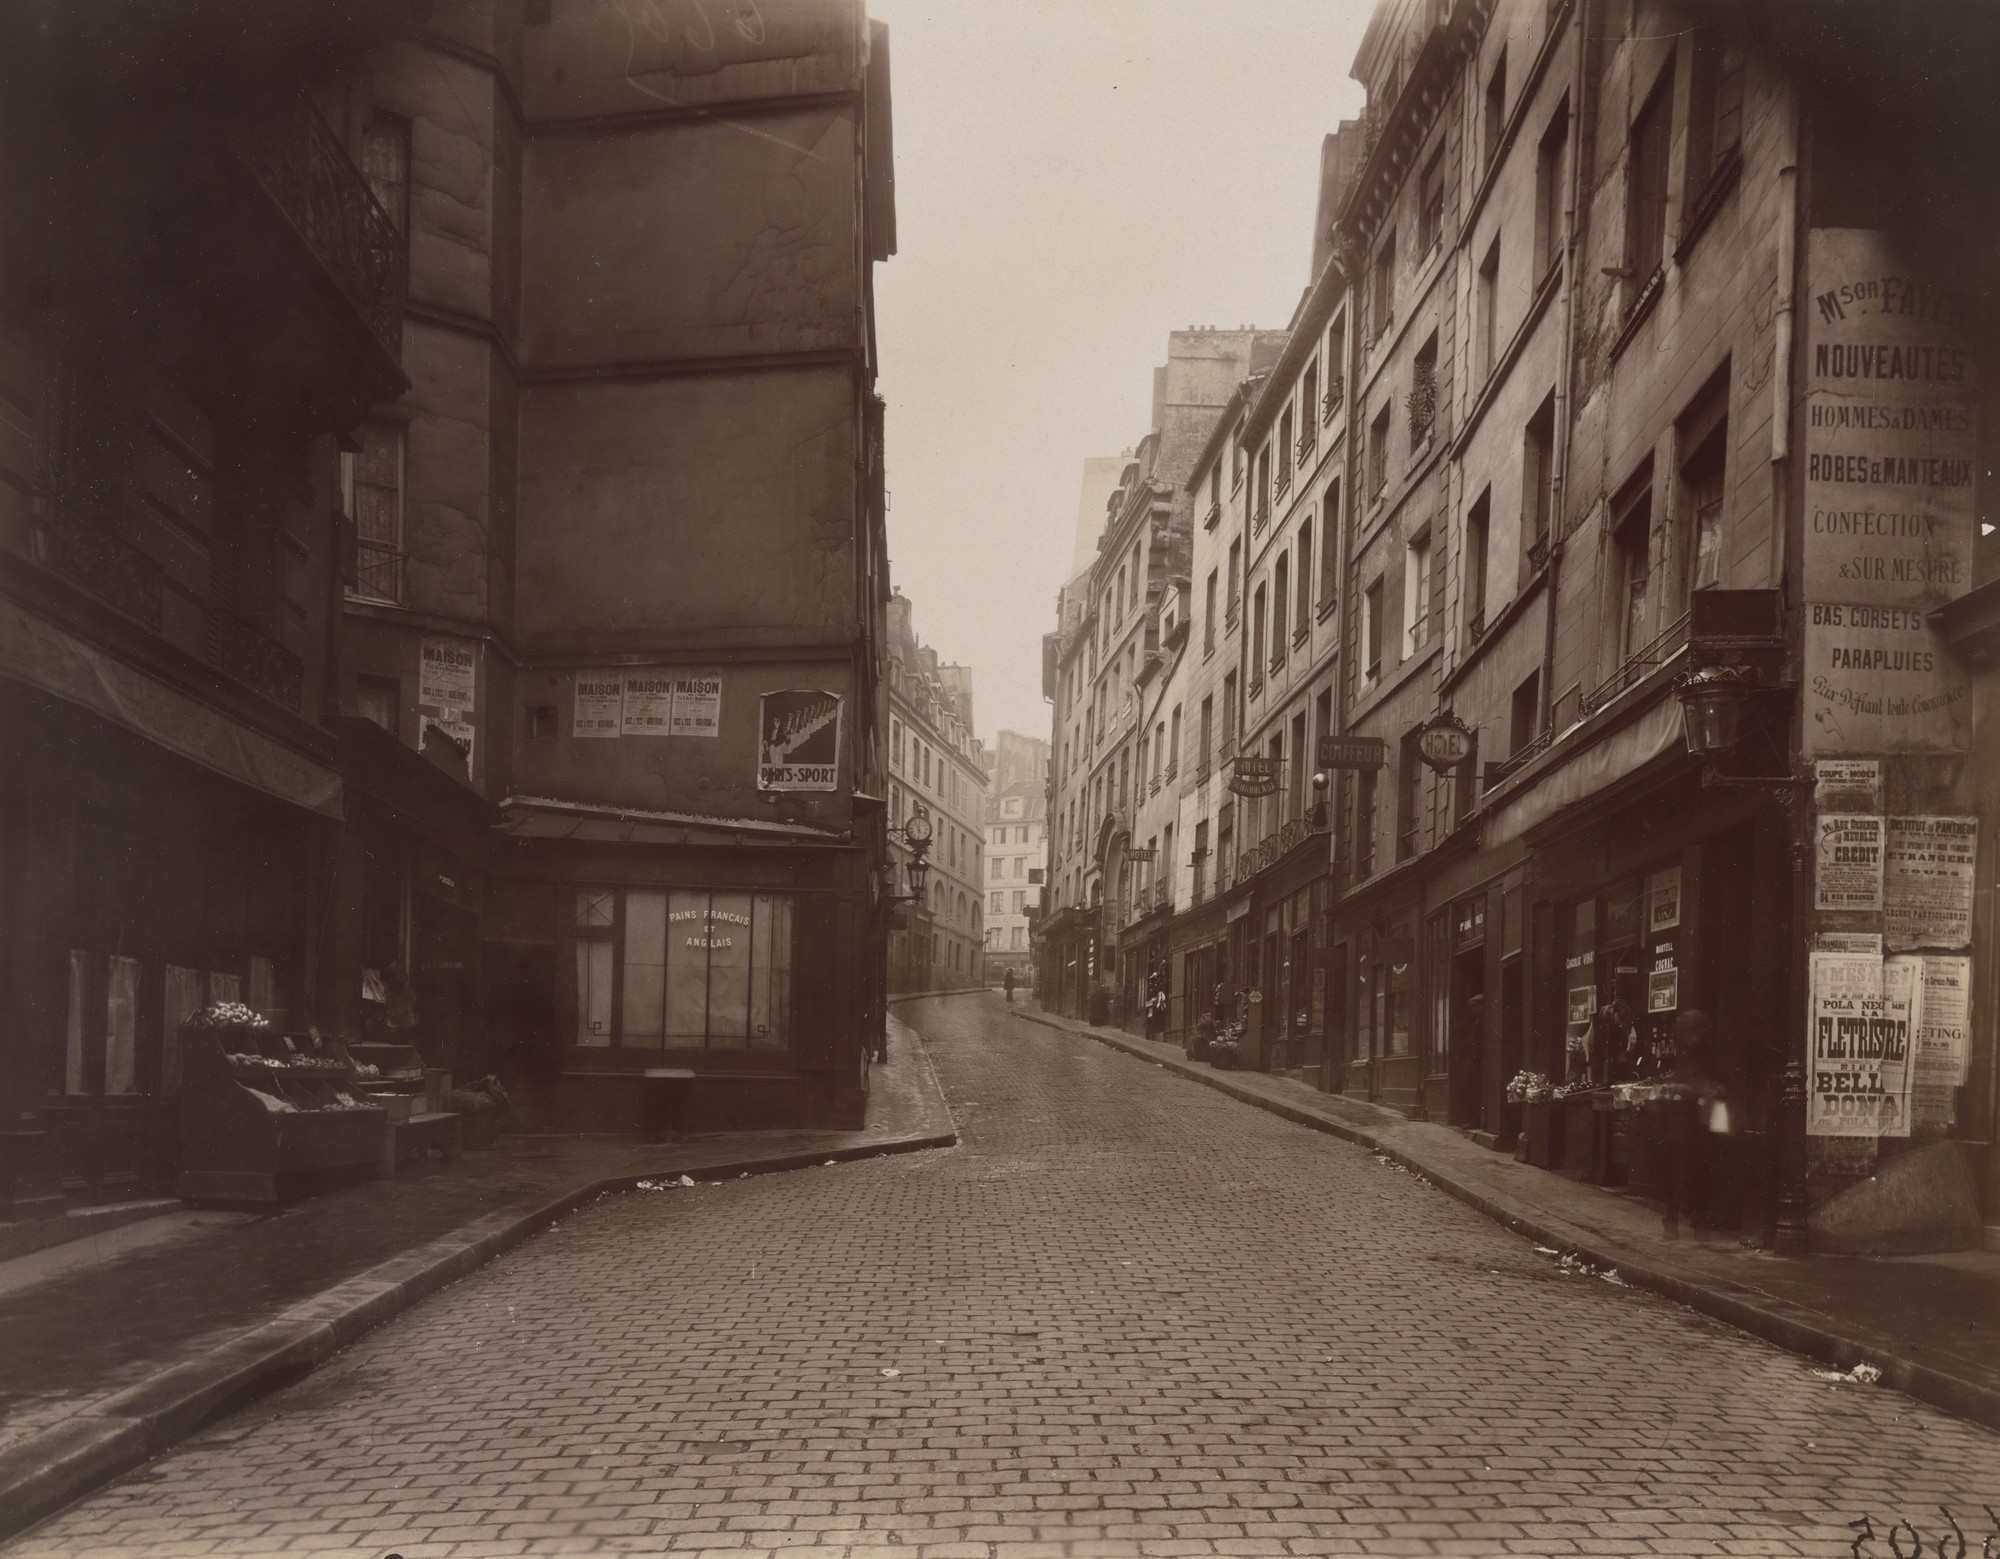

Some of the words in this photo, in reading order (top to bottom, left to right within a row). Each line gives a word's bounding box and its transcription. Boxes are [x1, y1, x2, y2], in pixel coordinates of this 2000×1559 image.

[1811, 405, 1890, 429] HOMMES
[1903, 408, 1968, 432] DAMES
[1810, 454, 1867, 483] ROBES
[1883, 457, 1973, 486] MANTEAUX
[1838, 562, 1850, 578] &
[1851, 556, 1885, 580] SUR
[1890, 559, 1961, 584] MESURE
[1850, 607, 1921, 630] CORSETS
[424, 646, 473, 667] MAISON
[1832, 647, 1934, 671] PARAPLUIES
[577, 683, 621, 696] MAISON
[627, 680, 671, 694] MAISON
[676, 680, 720, 694] MAISON
[443, 706, 459, 721] 17
[1320, 743, 1384, 763] COIFFEUR
[1819, 770, 1843, 778] COUPE
[1849, 770, 1876, 778] MODES
[1889, 818, 1927, 832] INSTITUT
[1843, 831, 1878, 842] MEUBLES
[1887, 851, 1974, 864] ETRANGERS
[669, 910, 697, 922] PAINS
[704, 925, 716, 933] ET
[686, 936, 733, 949] ANGLAIS
[1823, 1000, 1855, 1010] POLA
